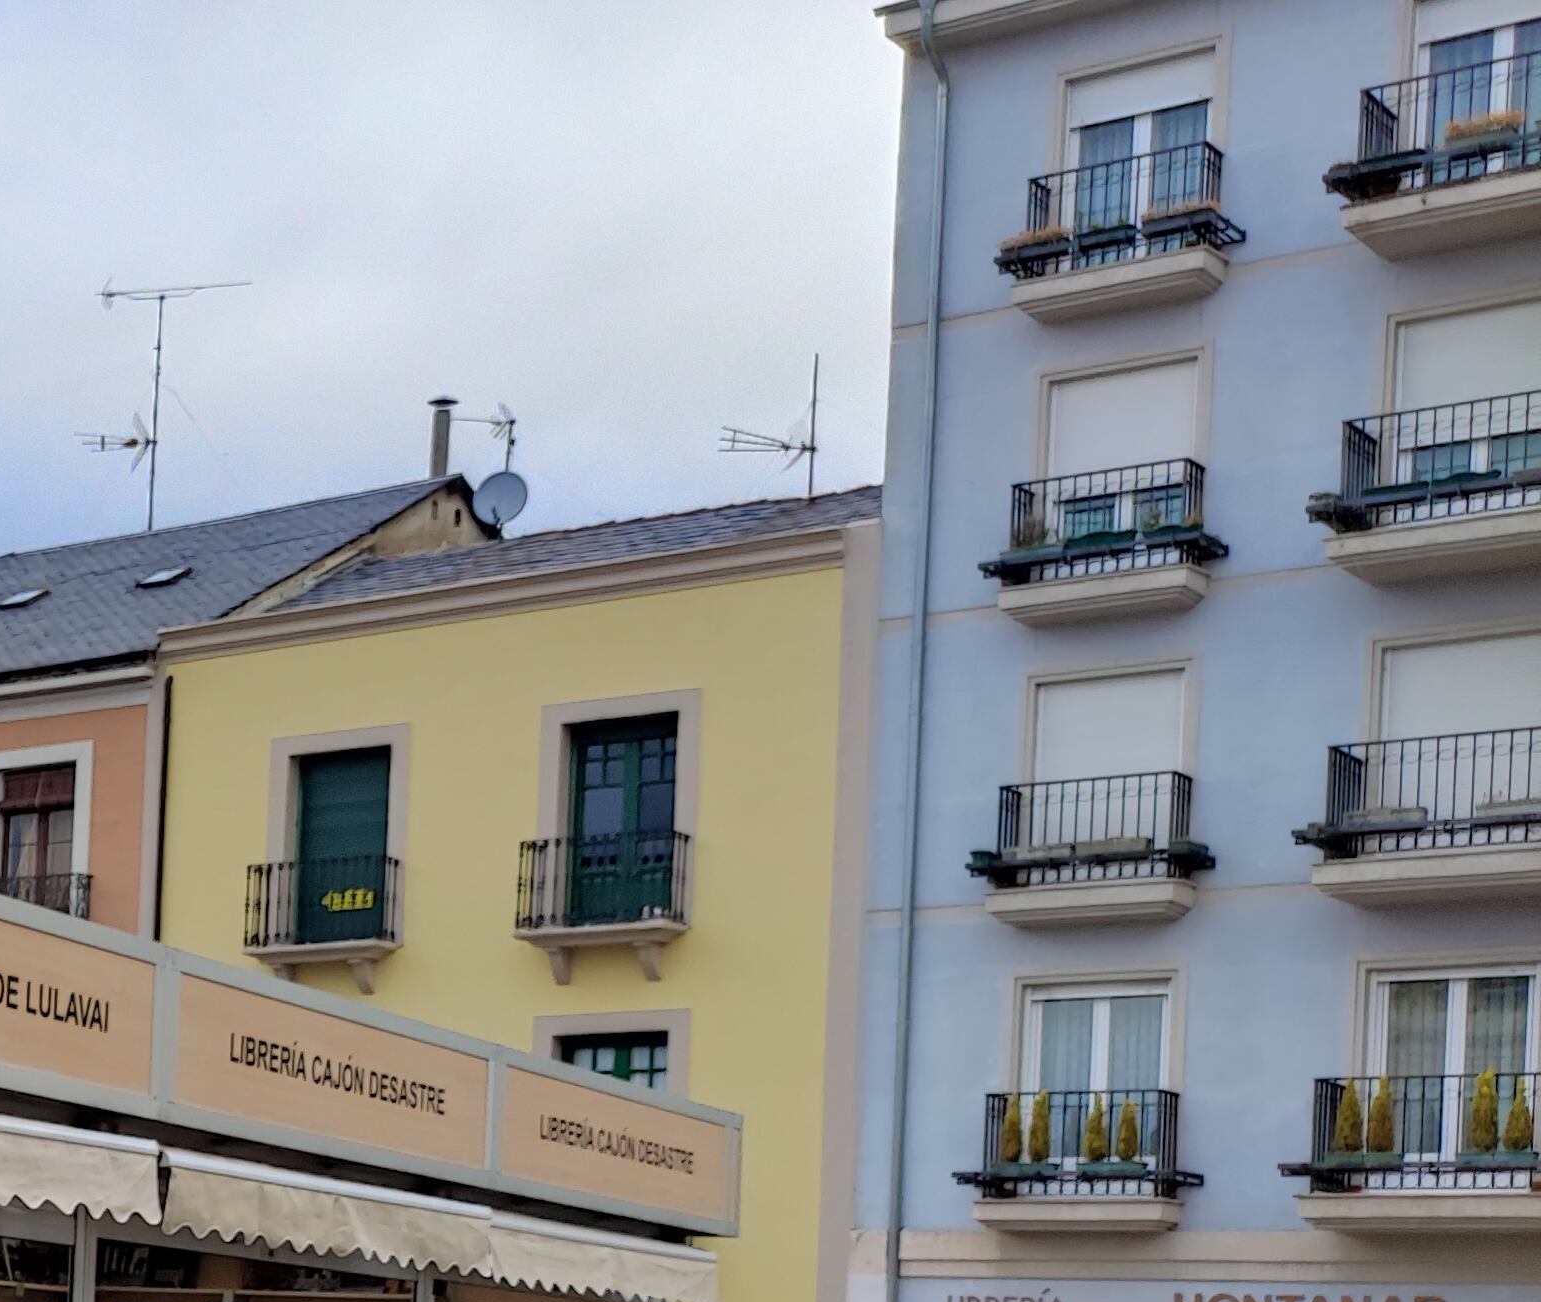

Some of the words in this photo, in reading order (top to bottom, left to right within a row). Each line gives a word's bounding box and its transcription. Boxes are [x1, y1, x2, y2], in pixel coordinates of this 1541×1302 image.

[25, 980, 110, 1034] LULAVAI
[229, 1031, 308, 1082] LIBRERÍA
[311, 1055, 365, 1097] CAJÓN
[368, 1071, 446, 1116] DESASTRE
[539, 1113, 593, 1150] LIBRERÍA
[596, 1126, 636, 1160] CAJÓN
[638, 1138, 694, 1174] DESASTRE
